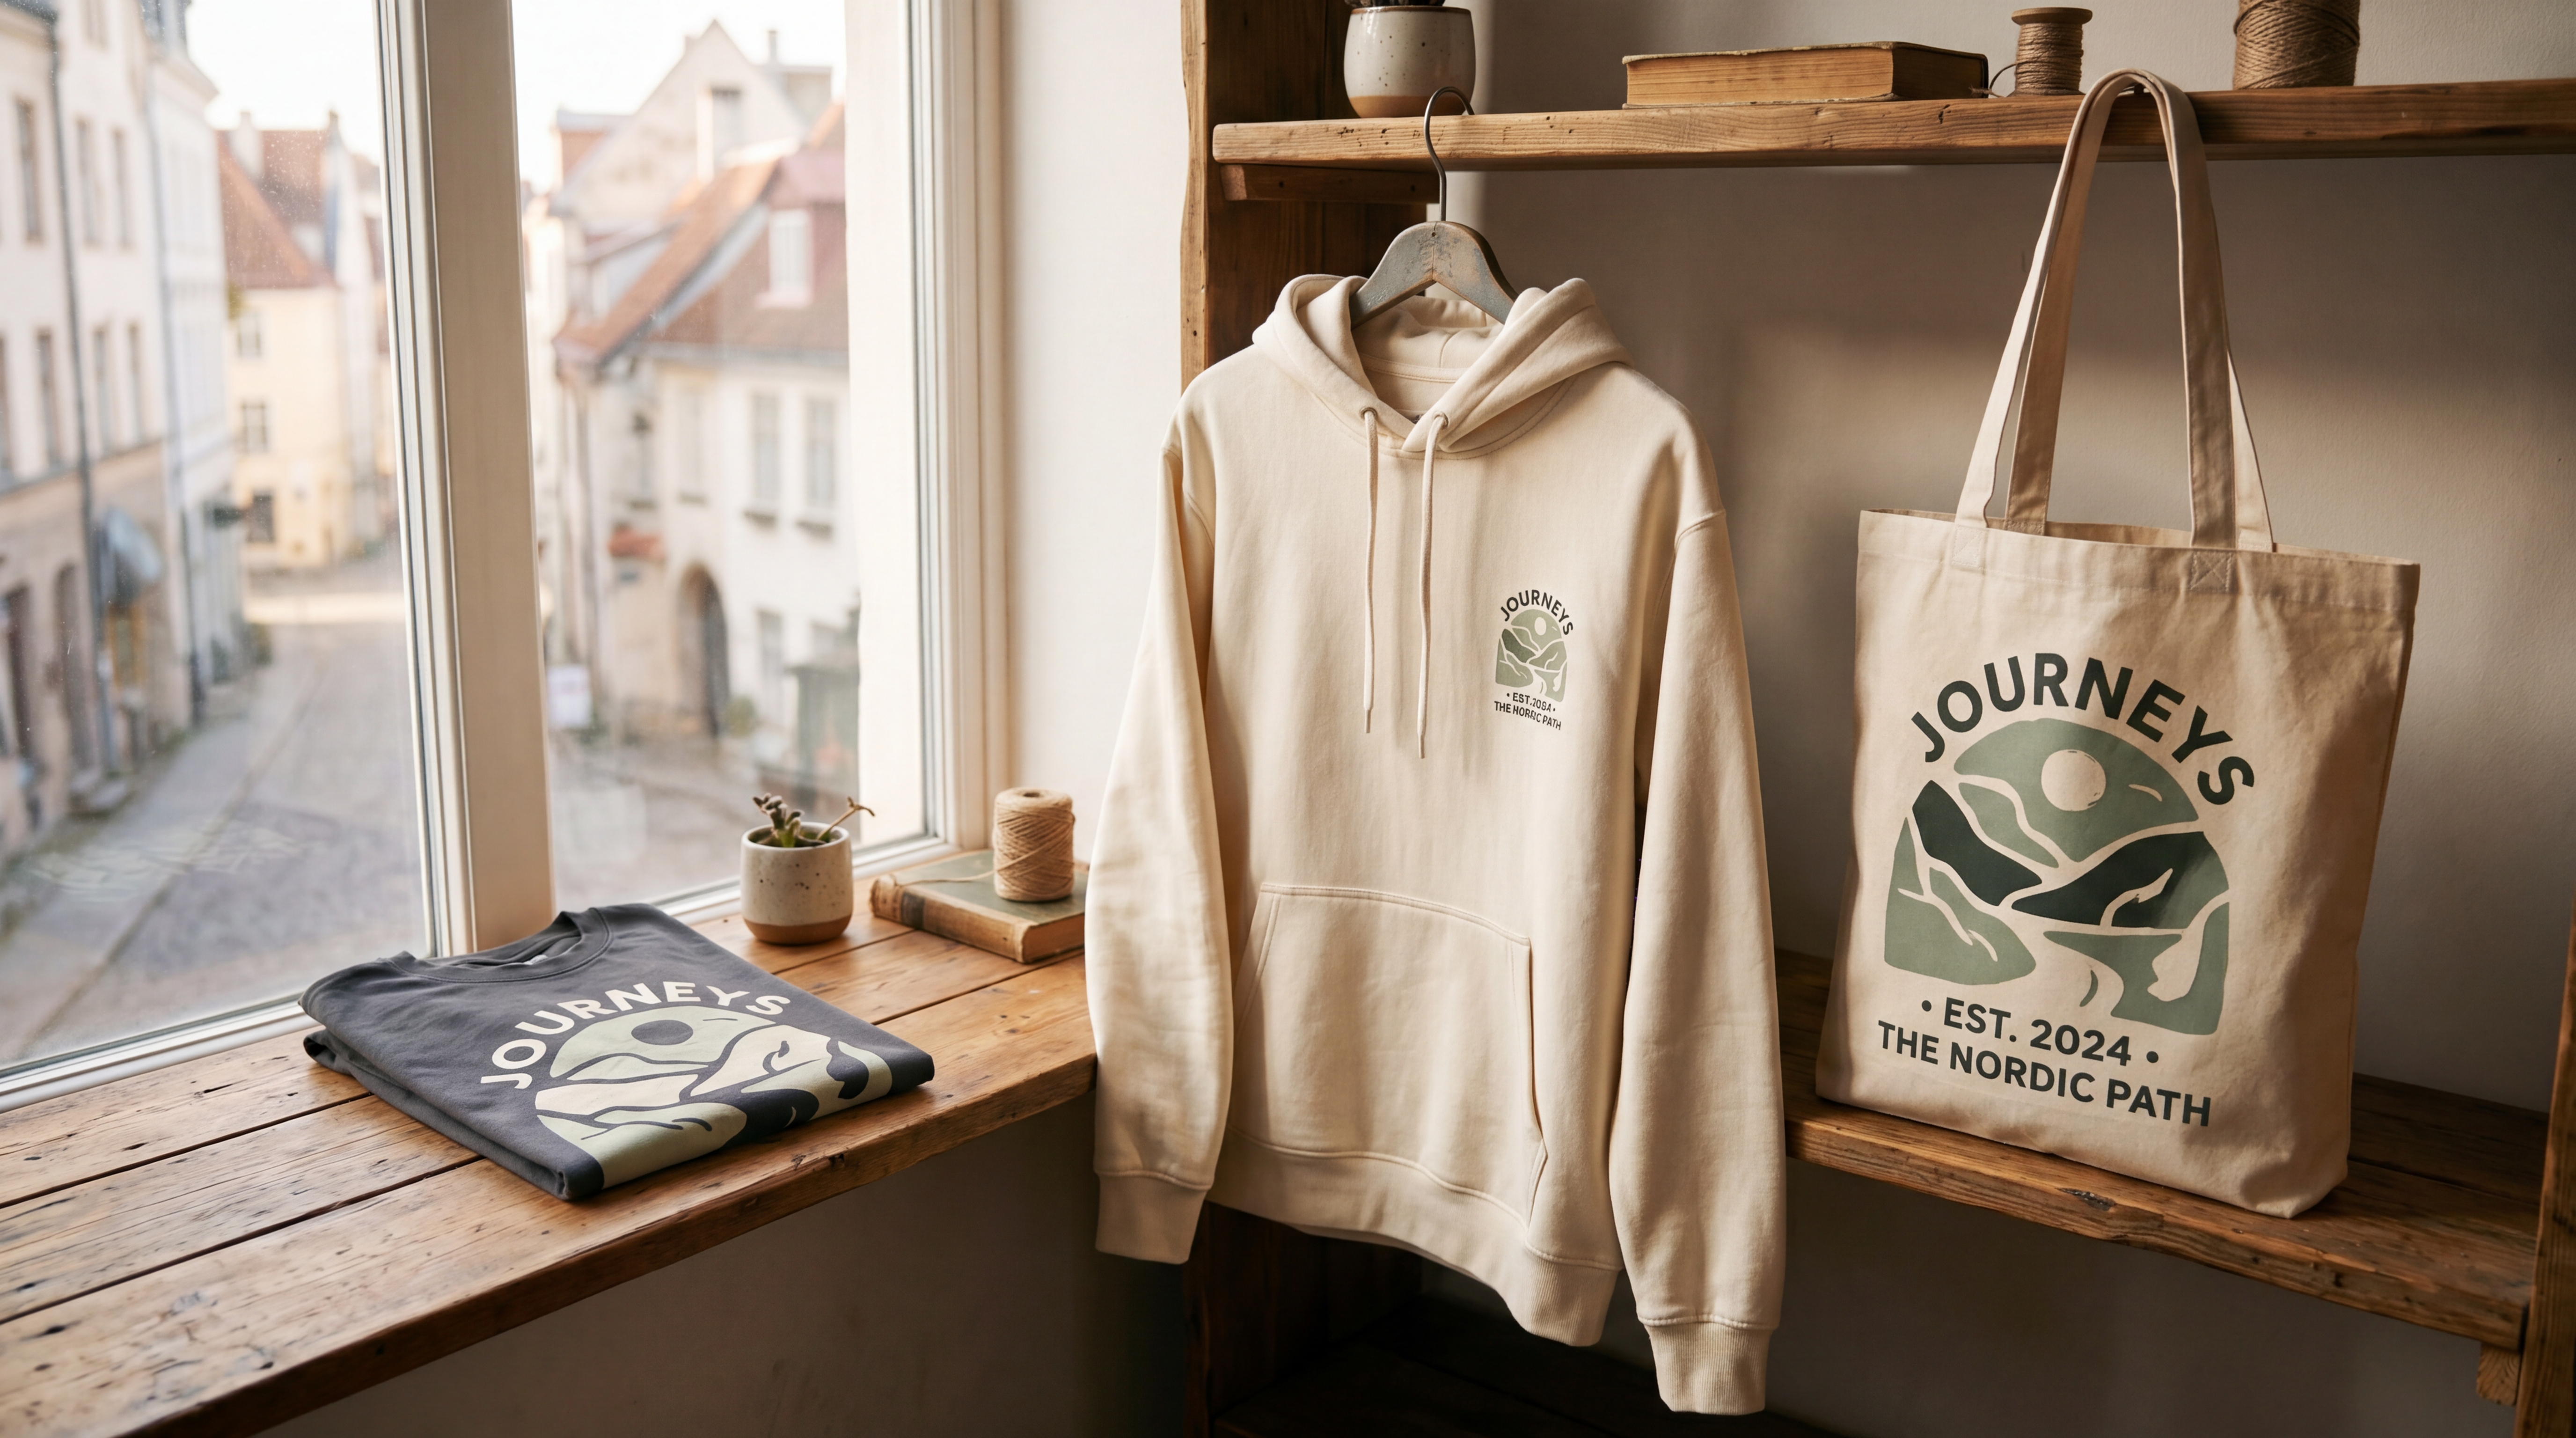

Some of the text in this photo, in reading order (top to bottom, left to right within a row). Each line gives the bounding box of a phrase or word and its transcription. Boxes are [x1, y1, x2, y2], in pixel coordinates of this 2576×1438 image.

[1500, 589, 1573, 635] JOURNEYS
[1494, 701, 1511, 713] THE
[1542, 715, 1561, 731] PATH
[1911, 653, 2255, 805] JOURNEYS
[480, 981, 791, 1089] JOURNEYS
[1878, 1020, 2211, 1127] THE NORDIC PATH
[1943, 997, 2132, 1066] EST. 2024
